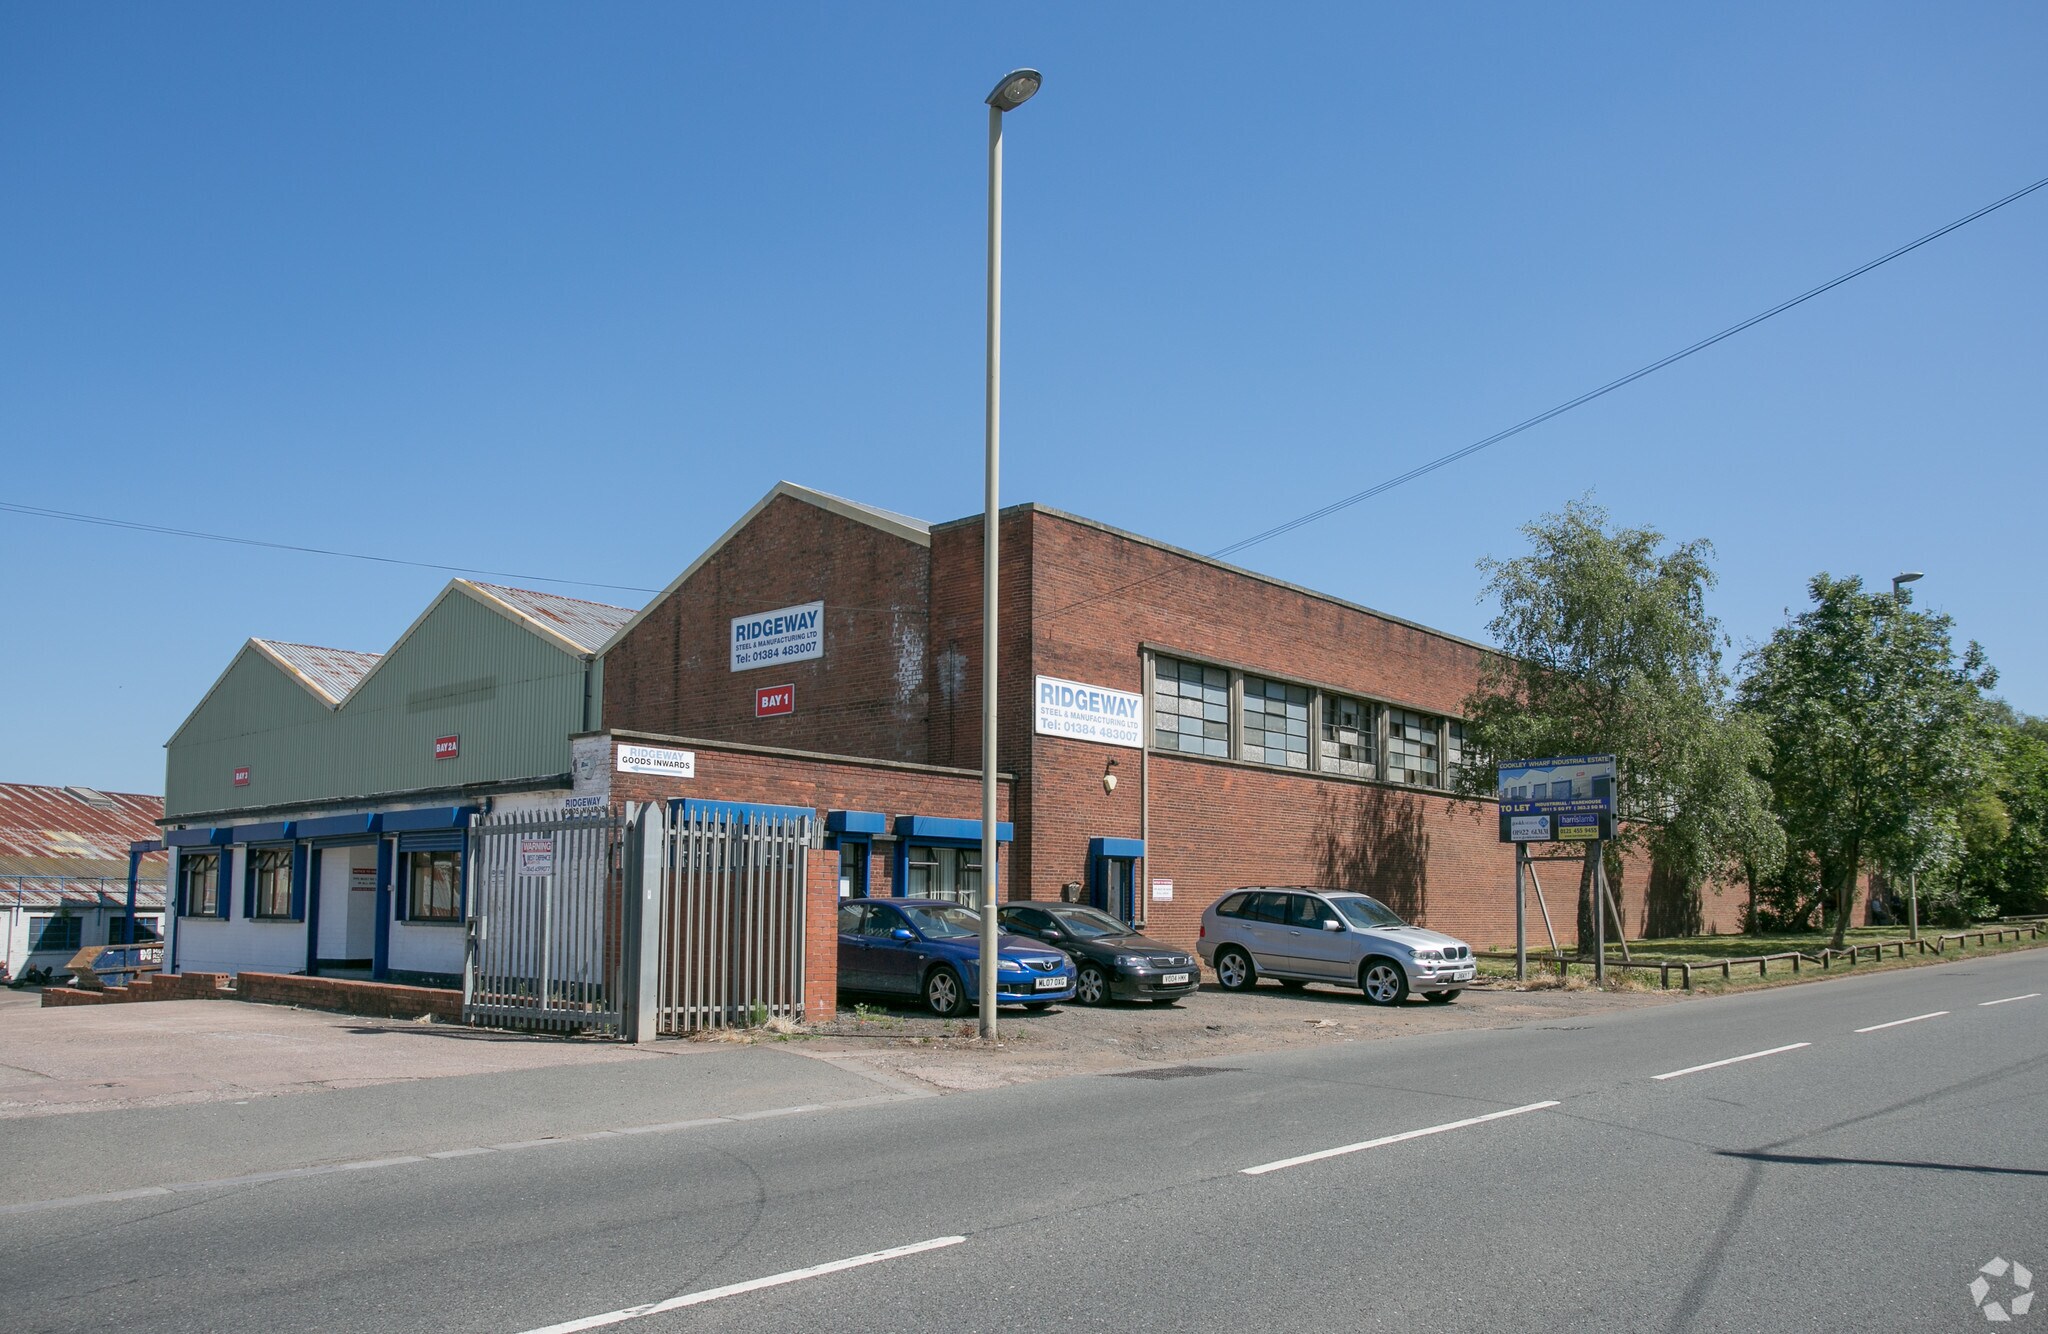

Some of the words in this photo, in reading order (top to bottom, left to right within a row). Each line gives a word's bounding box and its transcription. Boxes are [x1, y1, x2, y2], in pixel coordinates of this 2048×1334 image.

[736, 610, 818, 642] RIDGEWAY
[736, 642, 752, 652] STEEL
[758, 632, 806, 648] MANUFACTURING
[807, 630, 818, 639] LTD
[736, 653, 751, 664] Tel:
[752, 648, 779, 662] 01384
[782, 642, 817, 656] 483007
[762, 694, 782, 708] BAY
[784, 693, 789, 705] 1
[1041, 682, 1138, 718] RIDGEWAY
[1040, 706, 1062, 717] STEEL
[1071, 712, 1126, 726] MANUFACTURING
[1041, 718, 1061, 730] Tel:
[1064, 722, 1096, 736] 01384
[1099, 727, 1138, 742] 483007
[436, 743, 448, 752] BAY
[448, 742, 456, 750] 2A
[630, 747, 684, 760] RIDGEWAY
[622, 756, 651, 765] GOODS
[654, 759, 690, 769] INWARDS
[566, 796, 601, 807] RIDGEWAY
[523, 842, 551, 850] WARNING
